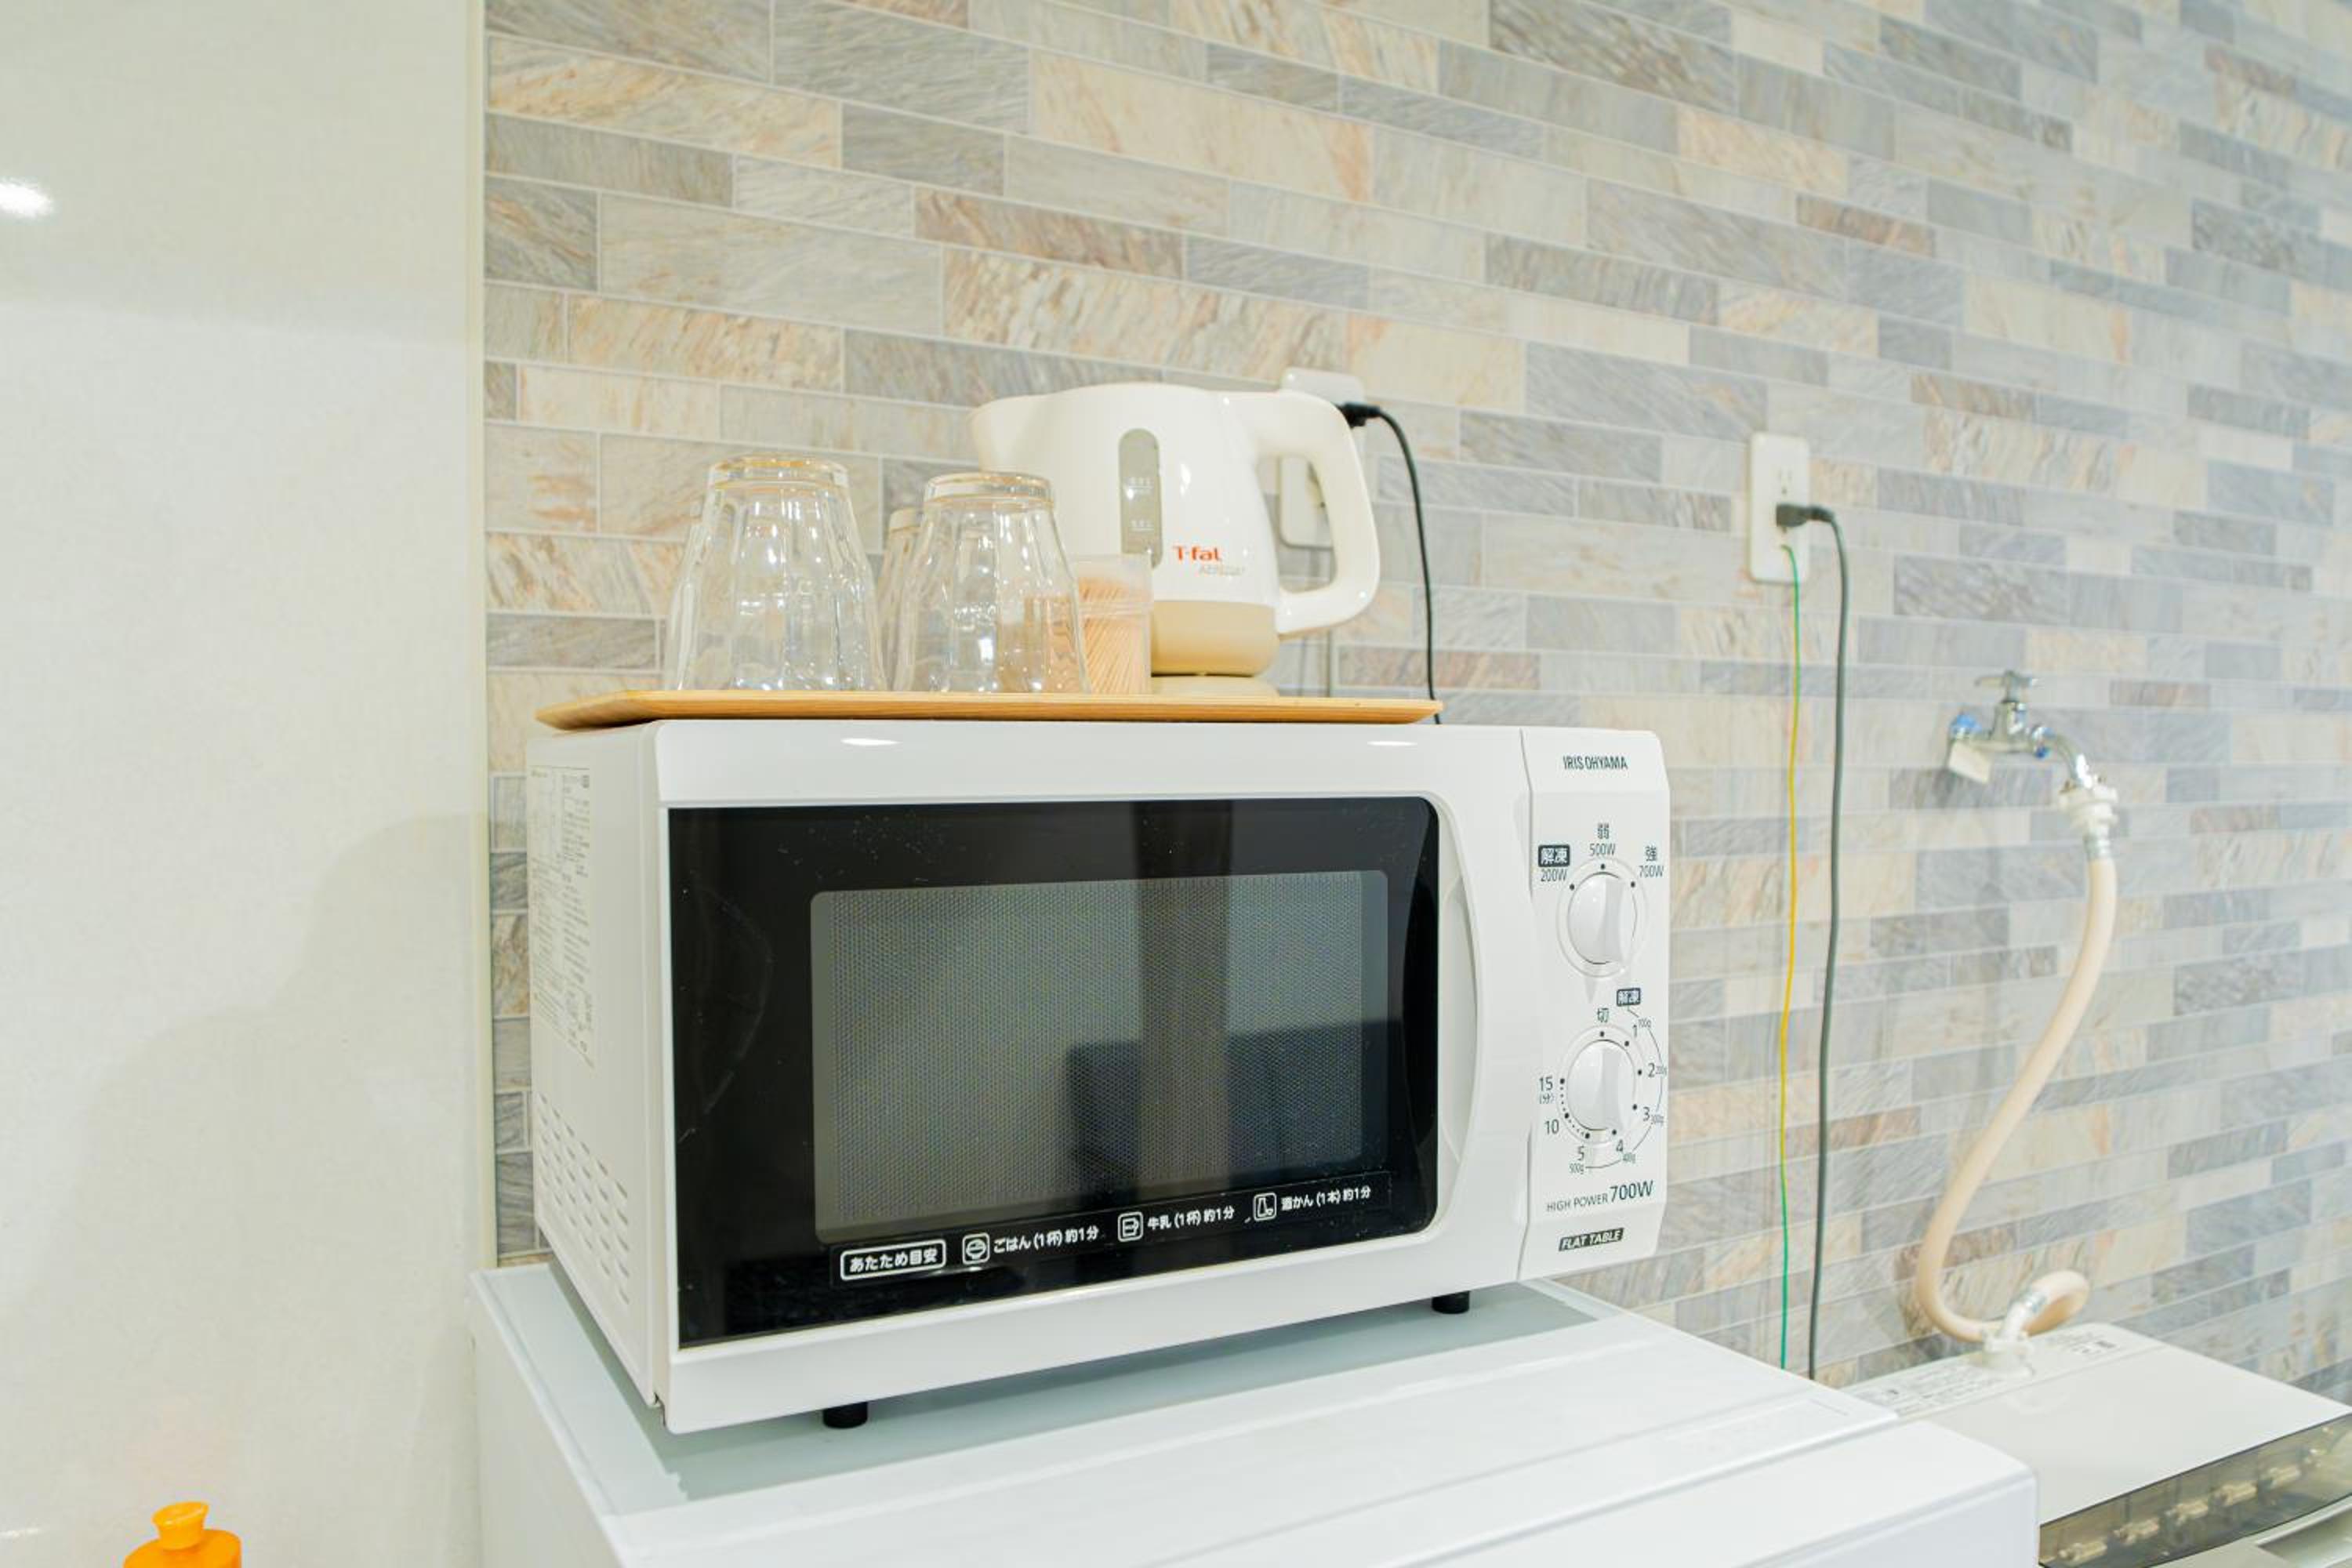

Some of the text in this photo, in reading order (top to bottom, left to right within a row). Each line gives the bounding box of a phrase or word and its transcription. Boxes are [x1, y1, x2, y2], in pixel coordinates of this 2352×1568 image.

[1563, 756, 1628, 769] IRIS OHYAMA
[1590, 844, 1615, 856] 500W
[1645, 846, 1657, 861] 強
[1541, 869, 1566, 881] 200W
[1639, 866, 1664, 877] 700W
[1632, 1025, 1638, 1038] 1
[1648, 1063, 1655, 1077] 2
[1539, 1077, 1553, 1091] 15
[1643, 1107, 1650, 1122] 3
[1544, 1120, 1559, 1134] 10
[1616, 1139, 1624, 1152] 4
[1577, 1146, 1584, 1161] 5
[1547, 1180, 1653, 1212] HIGH POWER 700W
[1590, 1229, 1621, 1244] TABLE
[850, 1248, 938, 1272] あたため目安
